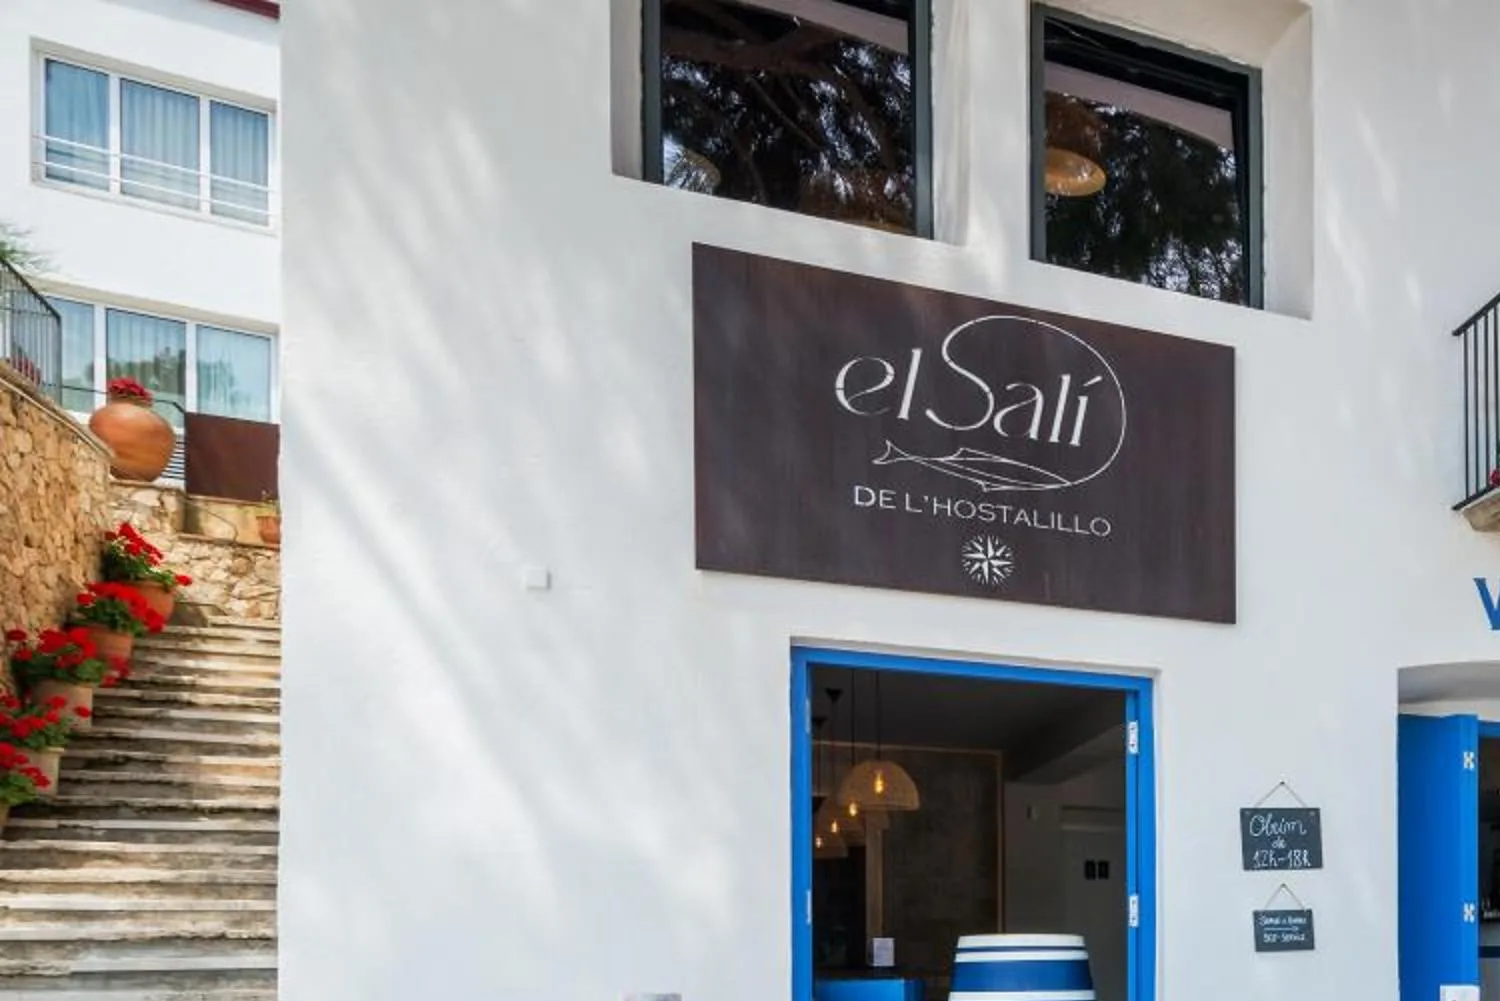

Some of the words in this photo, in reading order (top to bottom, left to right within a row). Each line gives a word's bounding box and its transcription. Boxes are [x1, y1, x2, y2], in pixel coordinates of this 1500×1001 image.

[835, 348, 922, 420] el
[853, 484, 897, 511] DE
[904, 491, 1112, 537] L'HOSTALILLO
